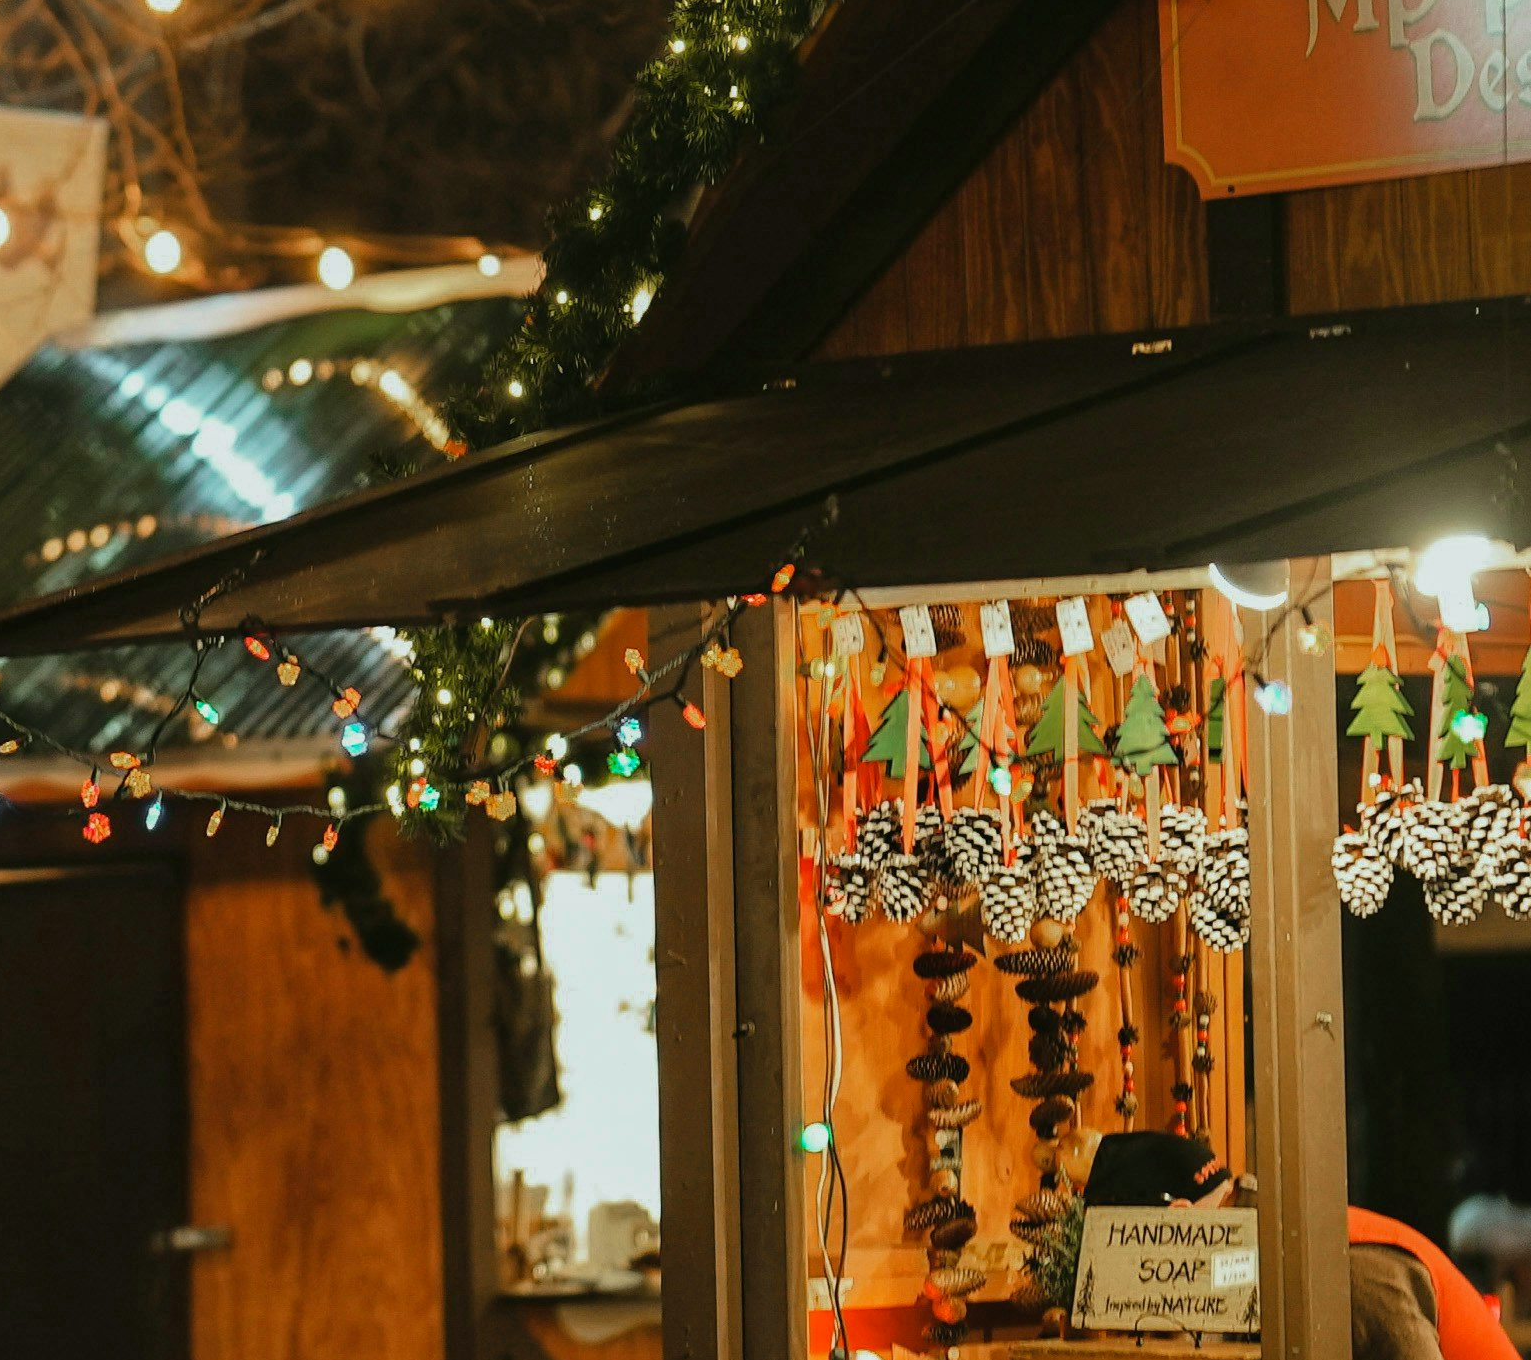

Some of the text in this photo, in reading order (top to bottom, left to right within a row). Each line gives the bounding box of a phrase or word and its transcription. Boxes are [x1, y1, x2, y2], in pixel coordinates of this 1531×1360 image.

[1107, 1222, 1243, 1248] HANDMADE
[1138, 1258, 1206, 1283] SOAP
[1105, 1294, 1146, 1318] Inspired
[1161, 1293, 1228, 1316] NATURE
